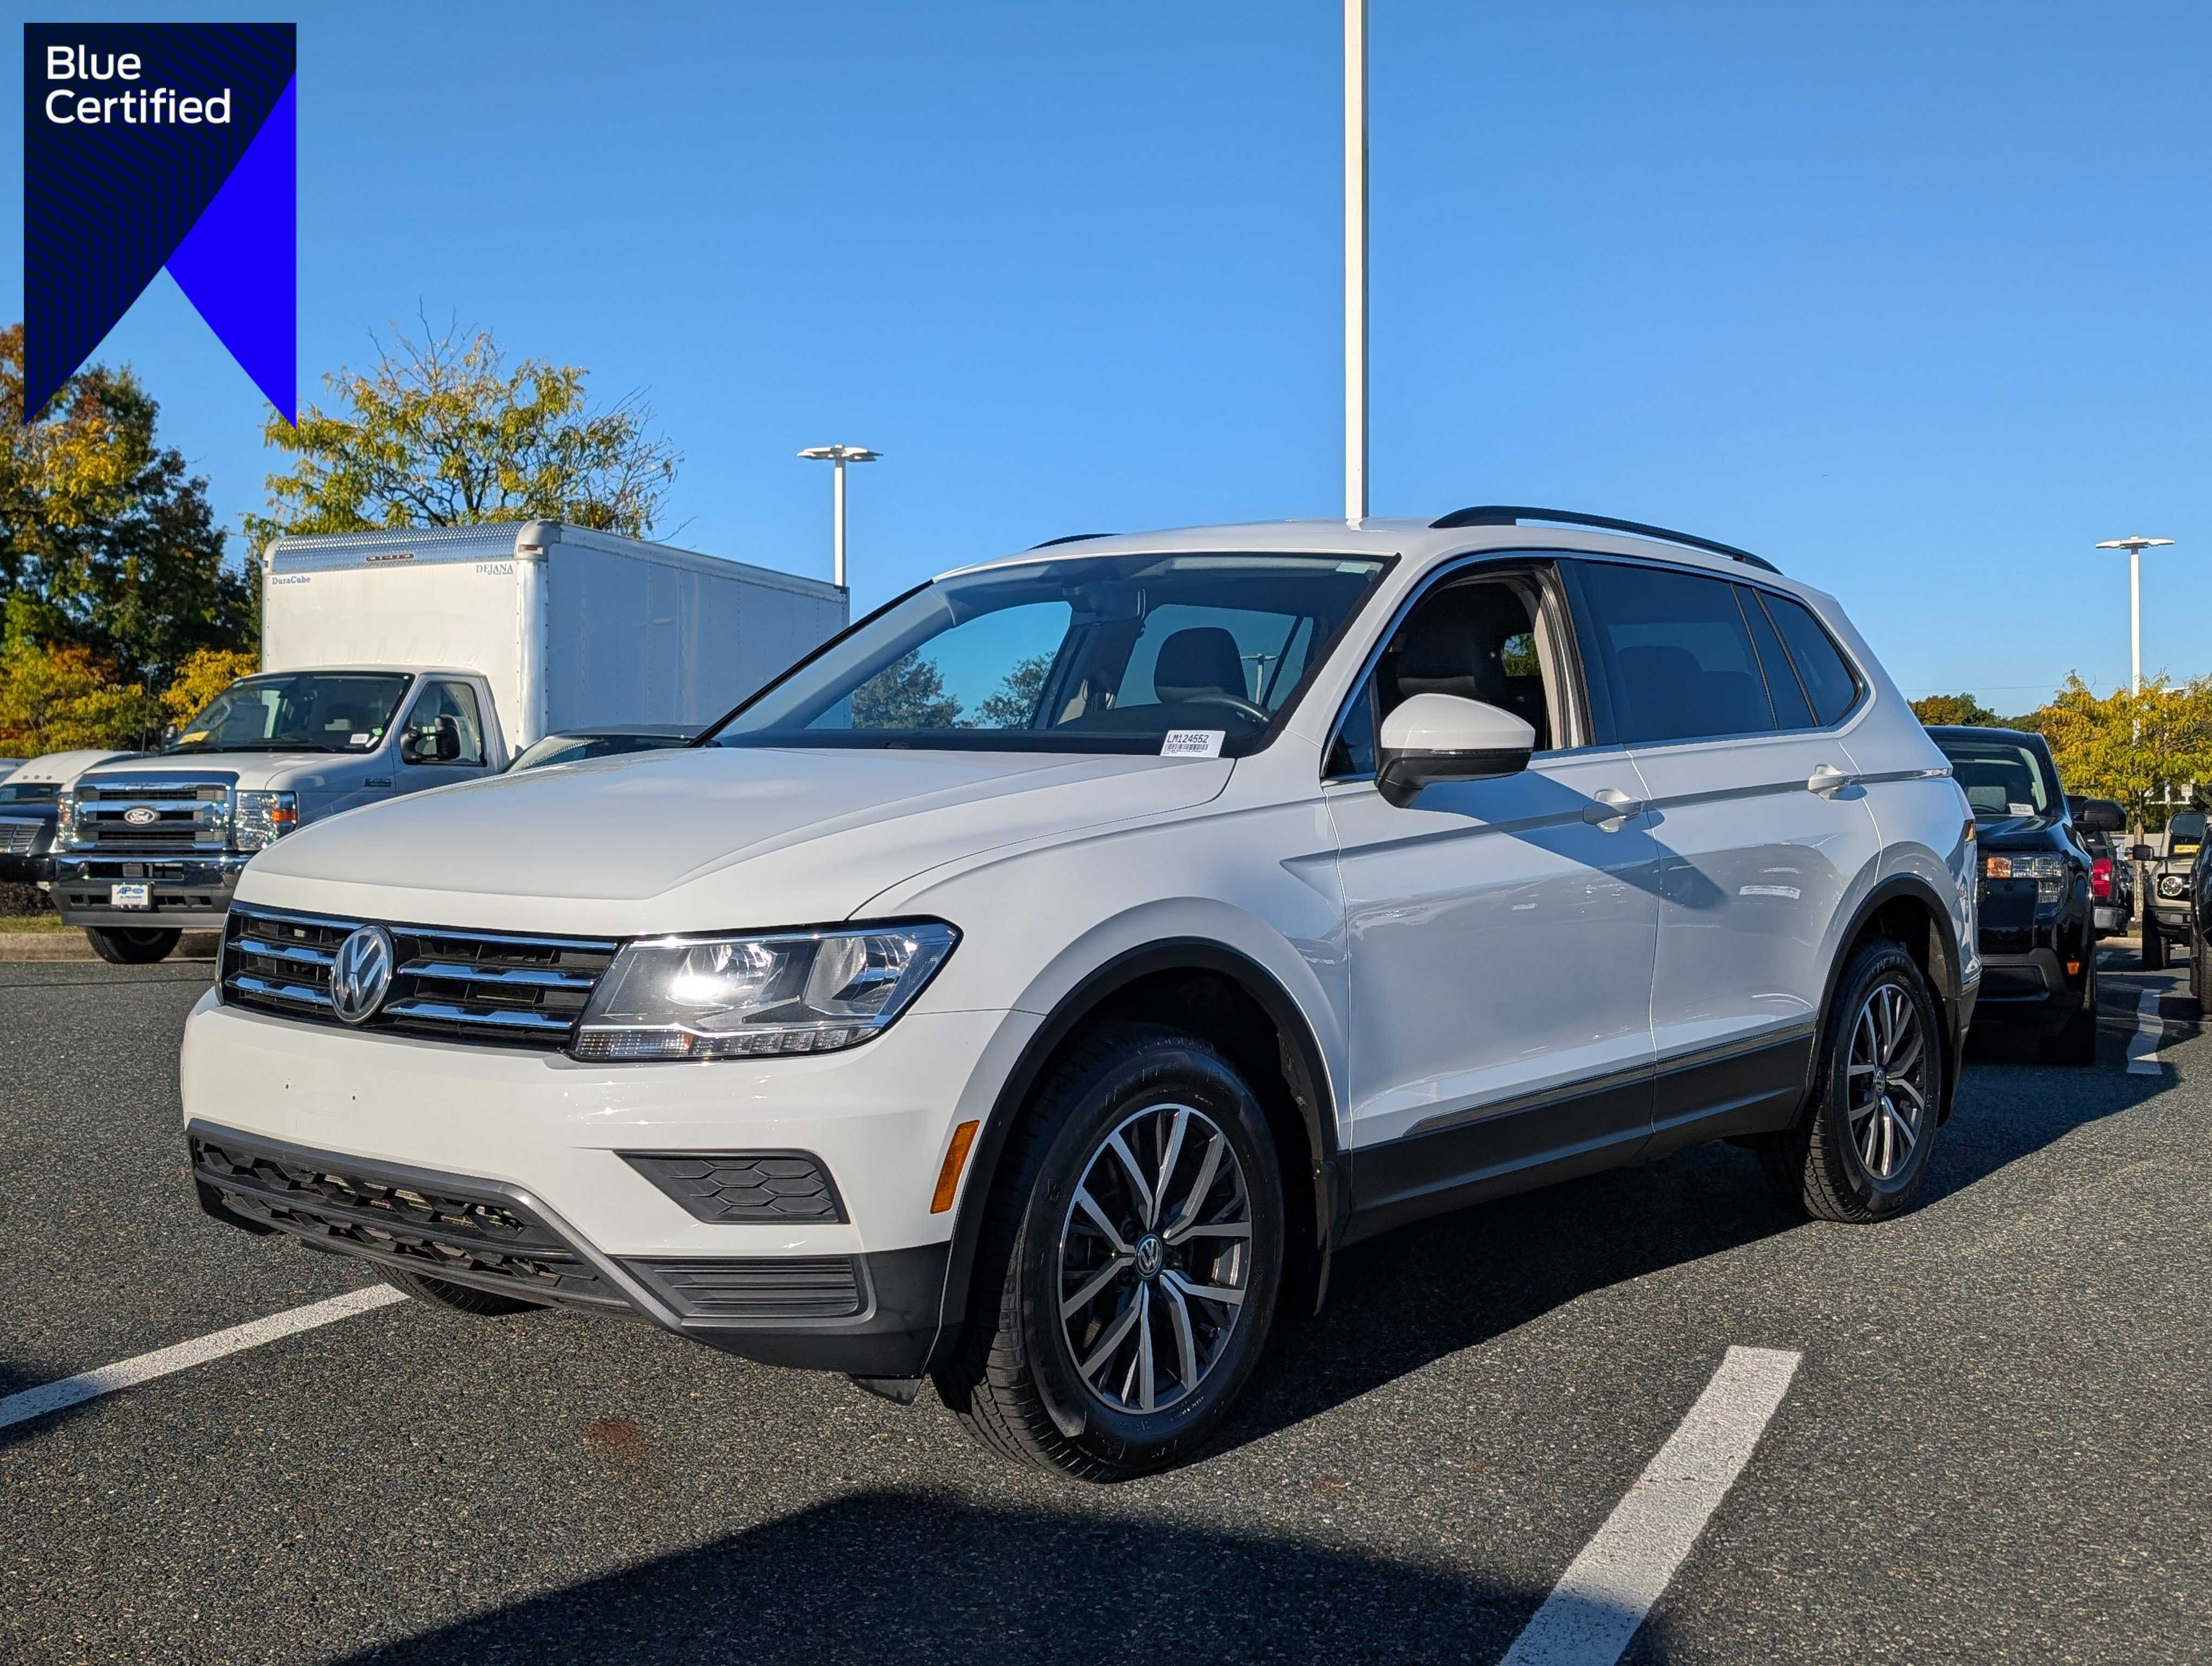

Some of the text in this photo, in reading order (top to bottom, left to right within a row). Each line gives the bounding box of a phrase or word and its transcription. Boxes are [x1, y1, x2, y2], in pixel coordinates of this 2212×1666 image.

[476, 563, 513, 575] DEJANA
[272, 575, 311, 585] DuraCube
[1167, 734, 1209, 744] LM124552
